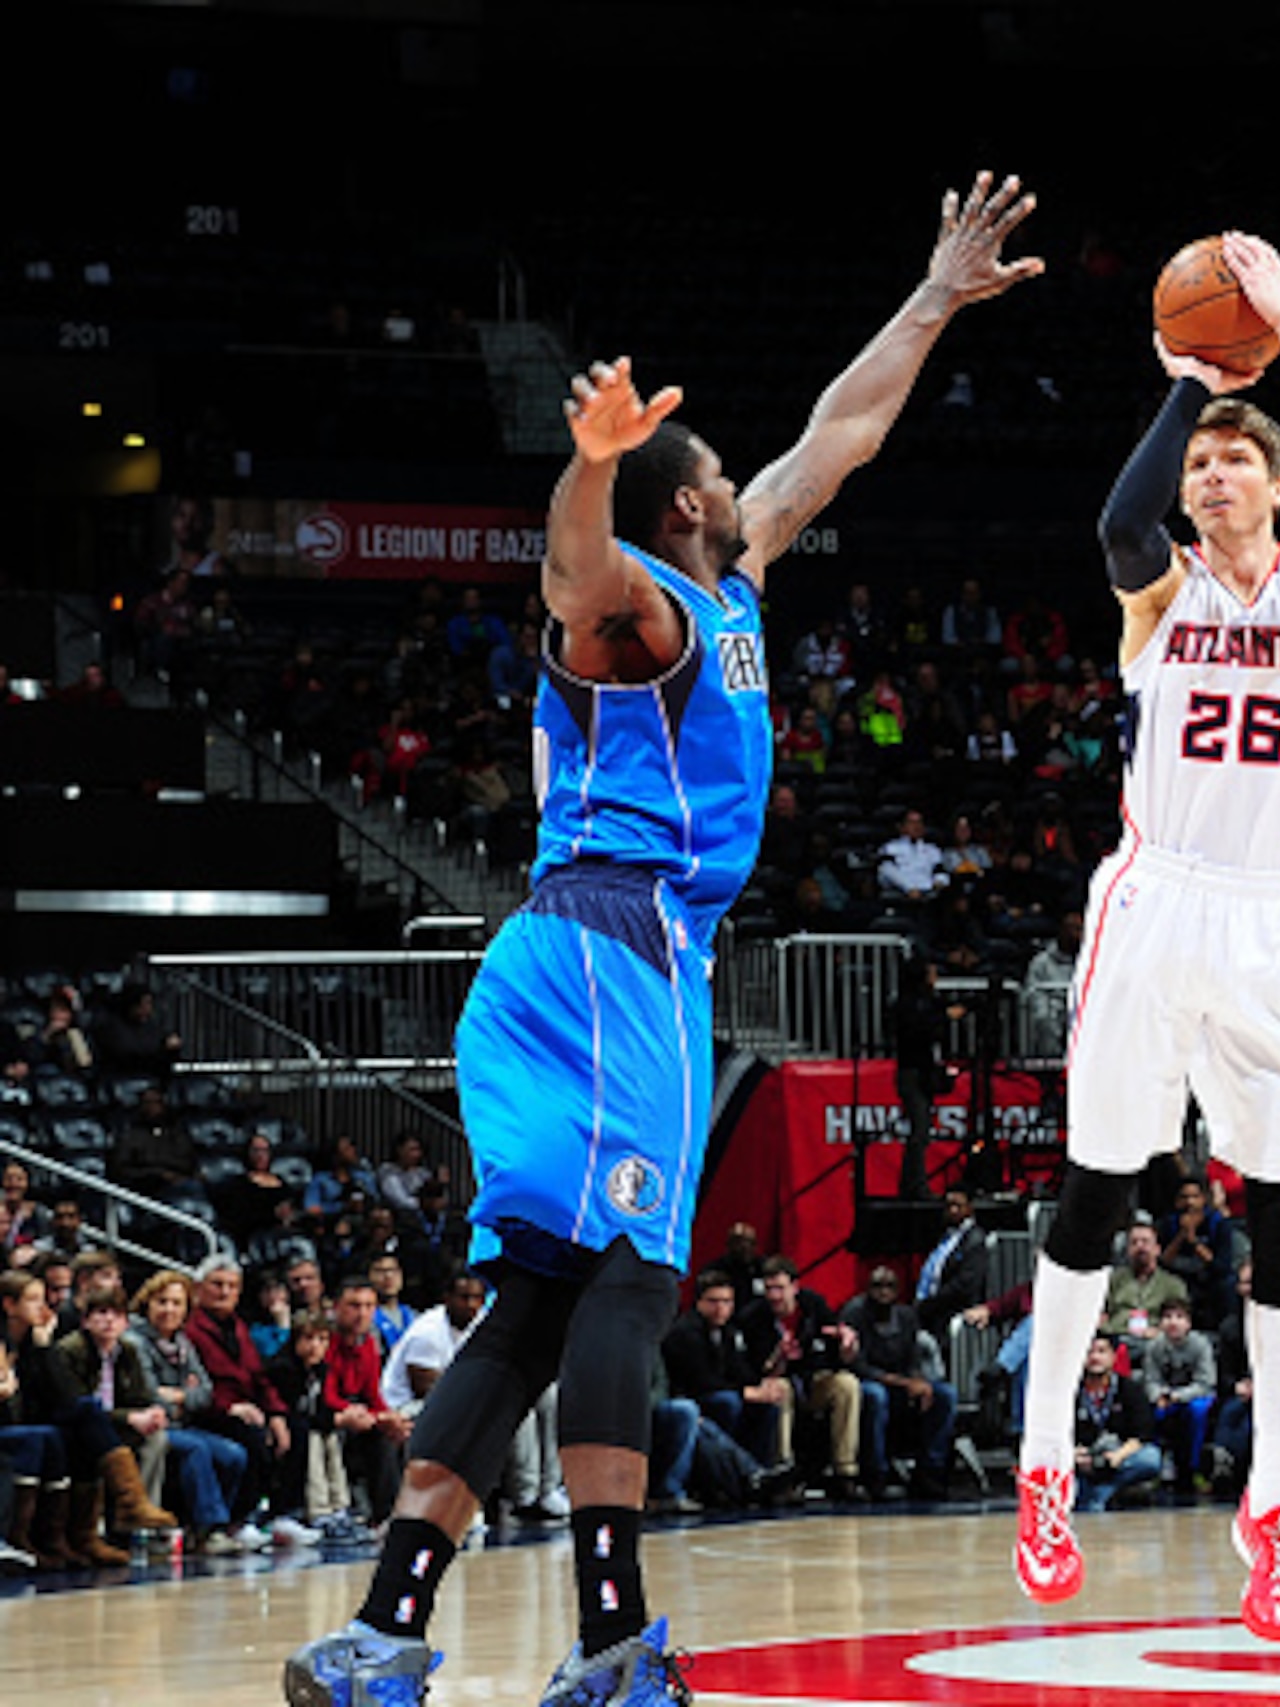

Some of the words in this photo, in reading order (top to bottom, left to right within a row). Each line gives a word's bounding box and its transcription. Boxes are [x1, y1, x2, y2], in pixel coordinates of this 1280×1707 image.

[184, 203, 241, 237] 201
[57, 318, 112, 349] 201
[357, 524, 446, 560] LEGION
[451, 528, 482, 562] OF
